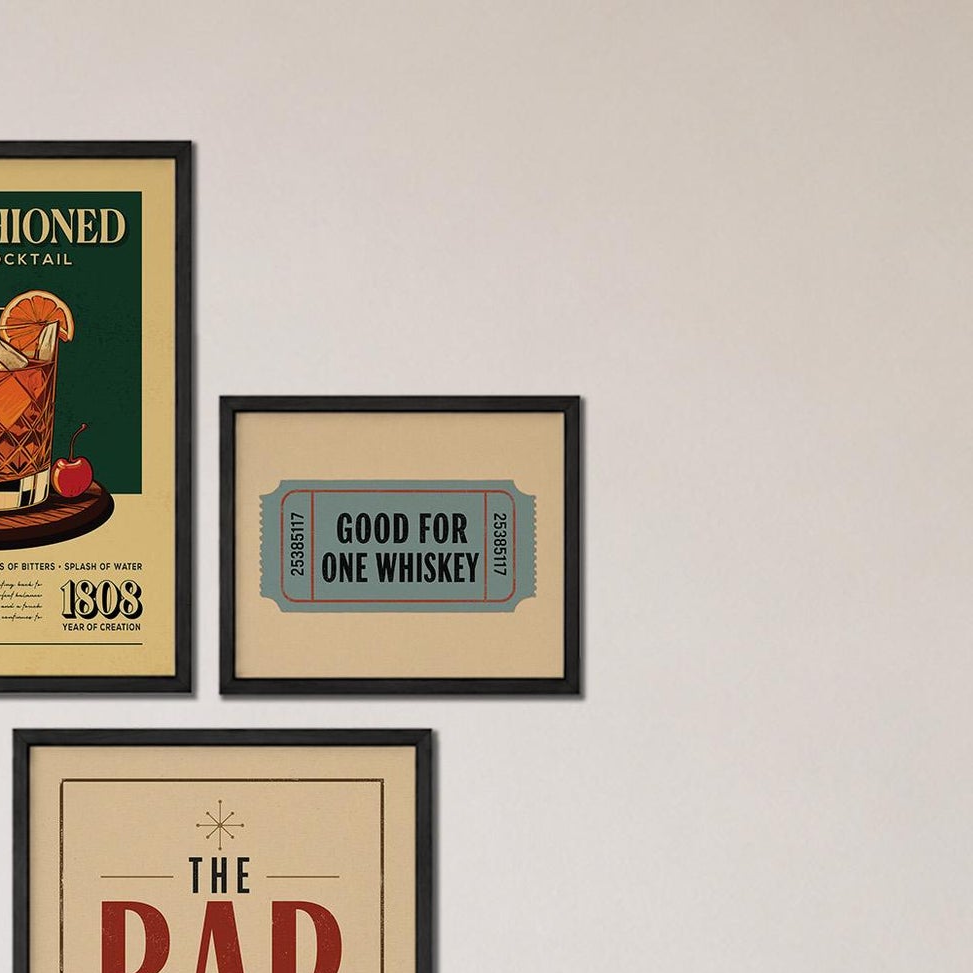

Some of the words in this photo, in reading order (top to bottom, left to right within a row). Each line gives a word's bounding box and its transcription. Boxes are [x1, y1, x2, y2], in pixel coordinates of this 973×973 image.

[290, 512, 305, 577] 25385117
[336, 512, 409, 544] GOOD
[419, 512, 468, 544] FOR
[493, 512, 508, 576] 25385117
[7, 562, 19, 571] OF
[21, 562, 56, 571] BITTERS
[64, 562, 97, 571] SPLASH
[99, 562, 111, 571] OF
[113, 562, 143, 571] WATER
[321, 552, 368, 583] ONE
[375, 552, 480, 583] WHISKEY
[59, 579, 144, 620] 1808
[62, 622, 85, 632] YEAR
[86, 622, 98, 632] OF
[99, 622, 141, 632] CREATION
[188, 856, 251, 894] THE
